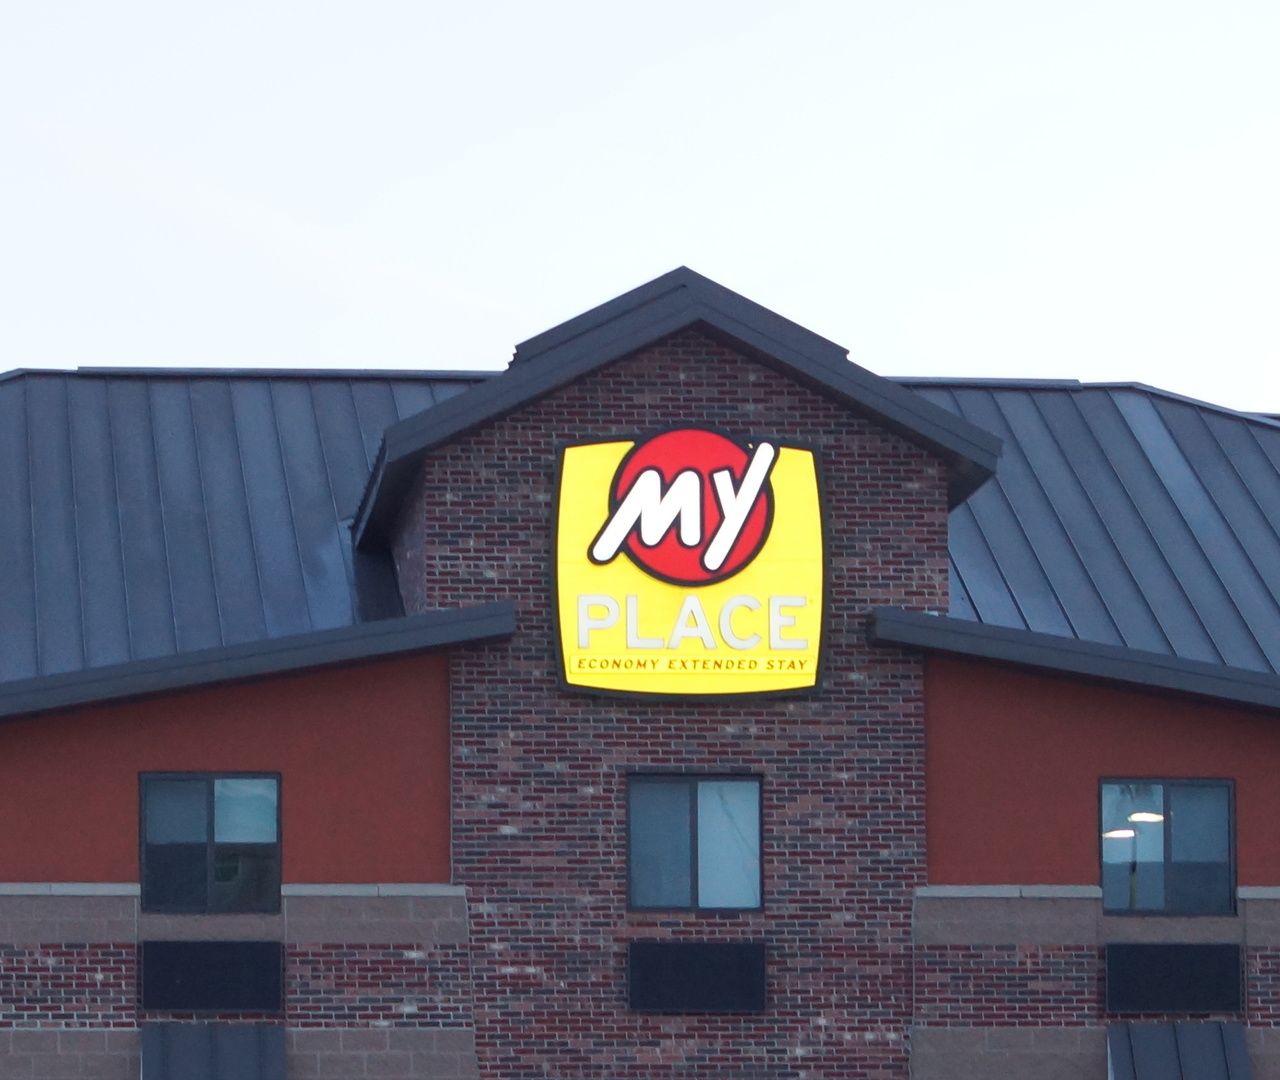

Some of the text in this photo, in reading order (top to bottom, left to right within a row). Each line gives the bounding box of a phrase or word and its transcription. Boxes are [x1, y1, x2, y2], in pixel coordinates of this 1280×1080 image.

[577, 594, 809, 651] PLACE
[577, 658, 809, 671] ECONOMY EXTENDED STAY
